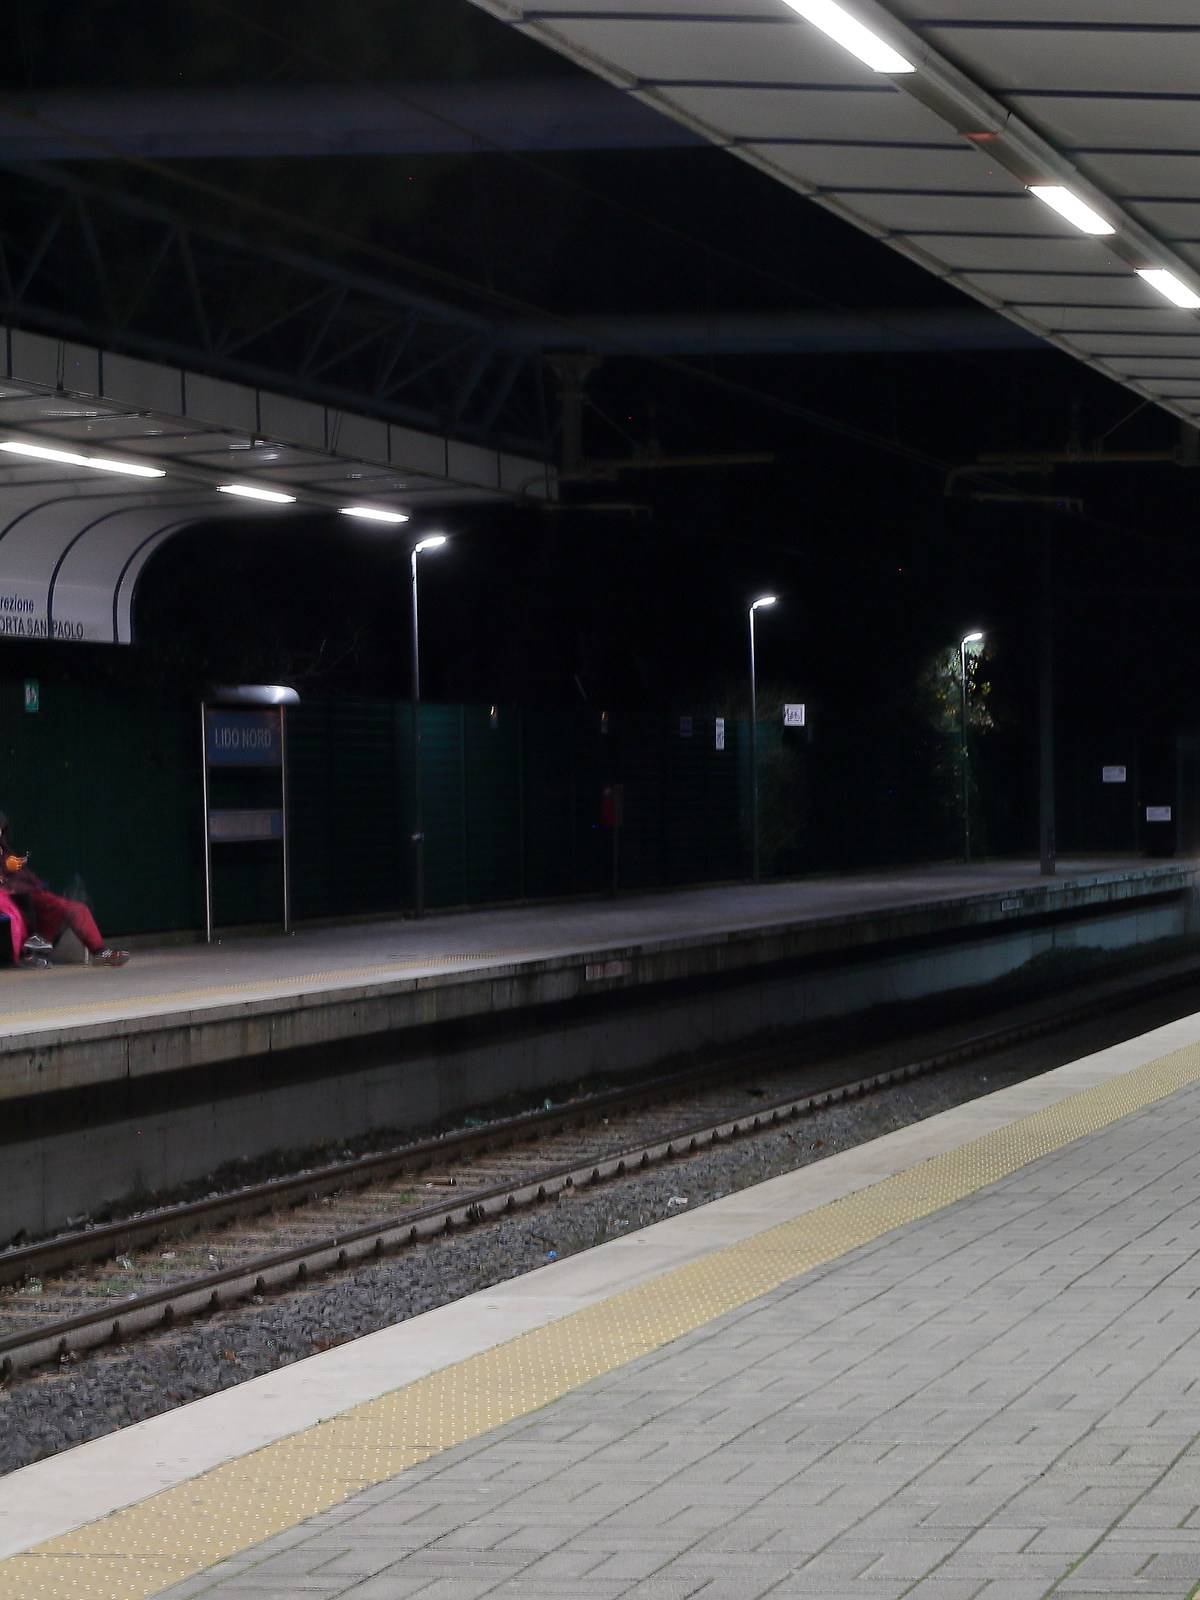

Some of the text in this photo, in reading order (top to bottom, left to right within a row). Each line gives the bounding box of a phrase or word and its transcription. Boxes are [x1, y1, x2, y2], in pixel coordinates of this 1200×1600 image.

[27, 617, 47, 637] SAN
[53, 620, 84, 640] PAOLO
[215, 728, 271, 748] LIDO NORD
